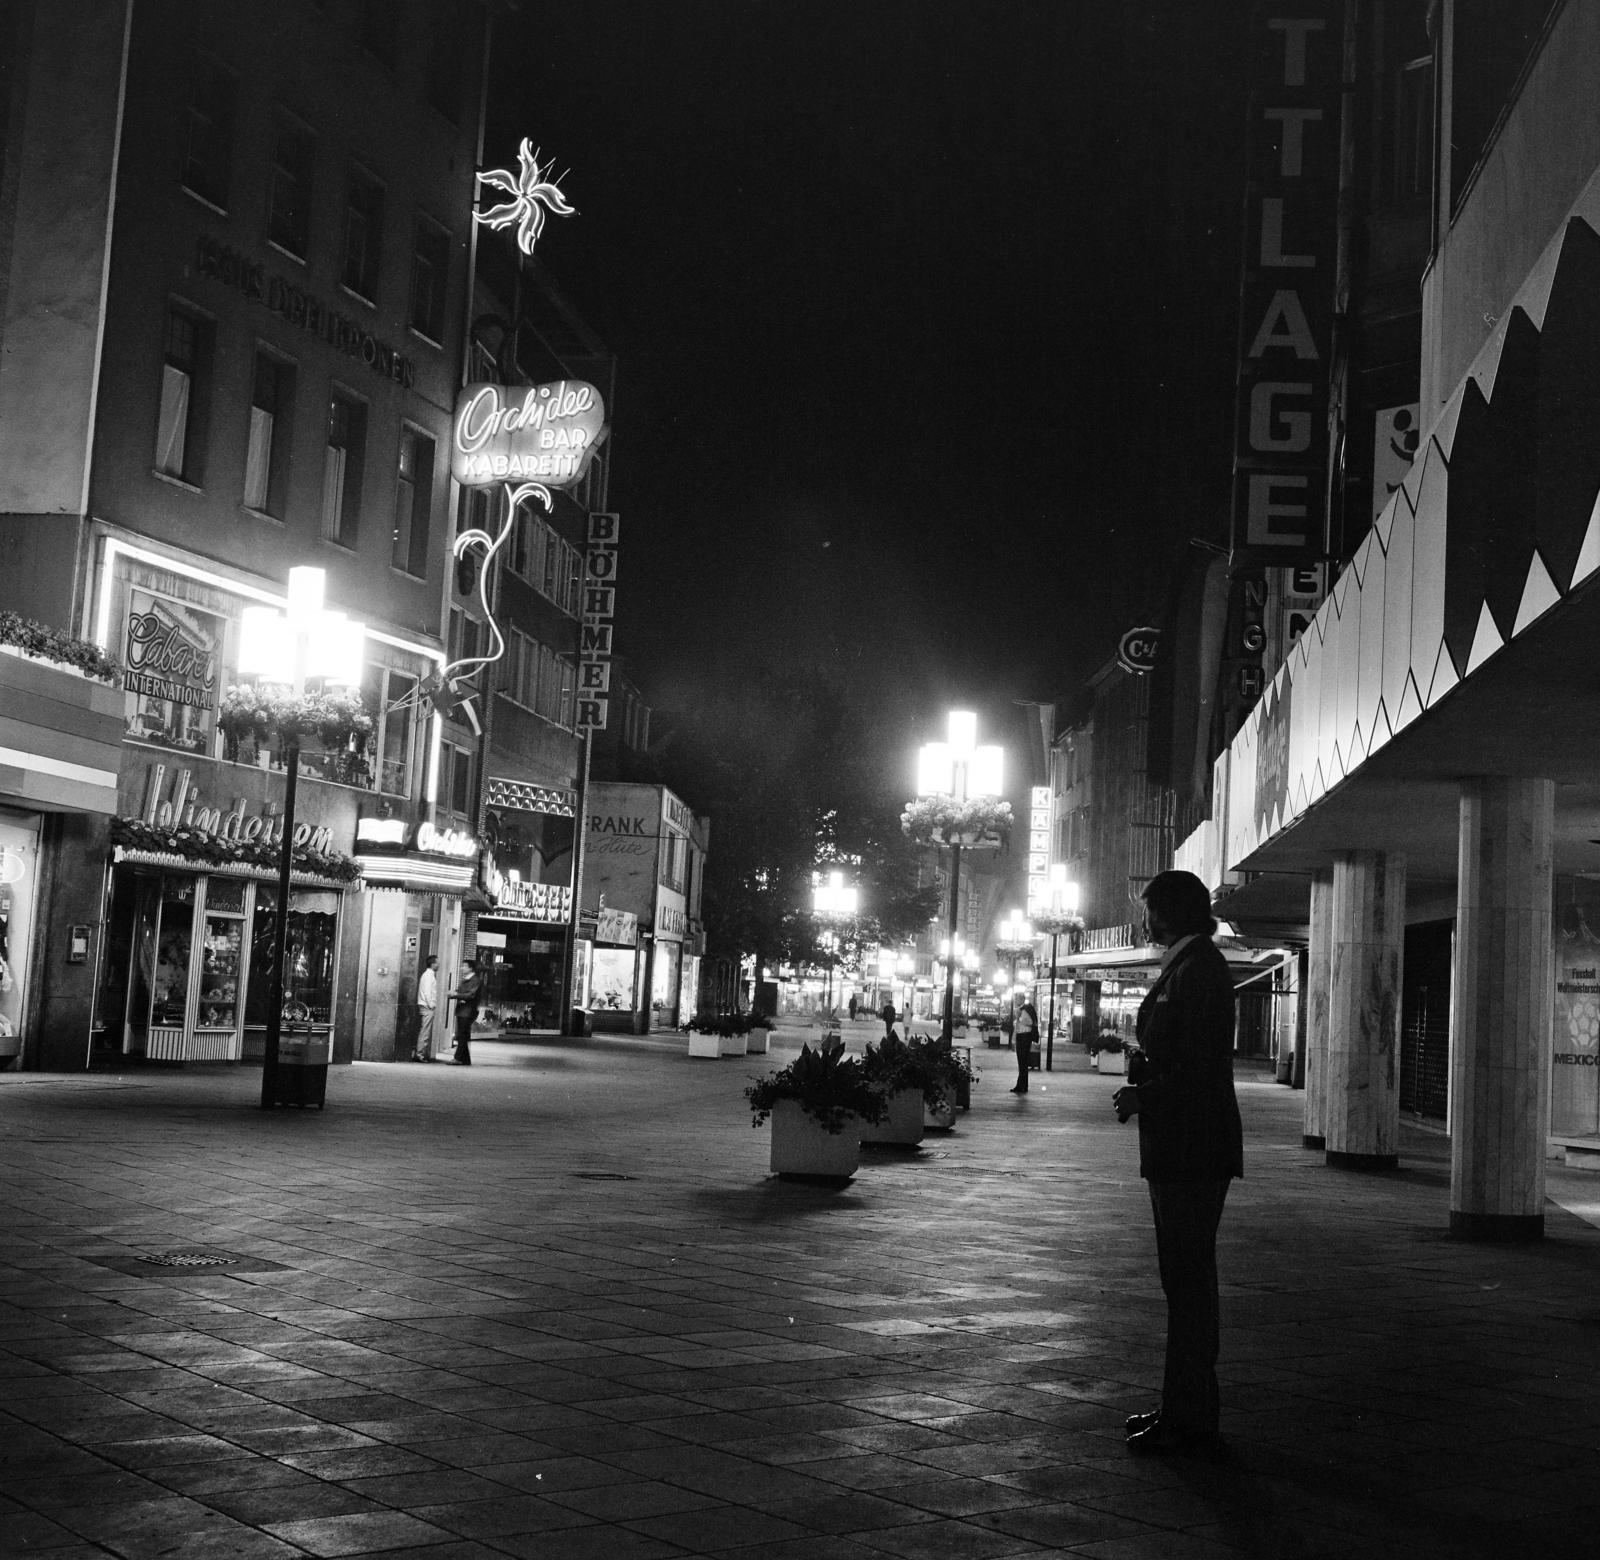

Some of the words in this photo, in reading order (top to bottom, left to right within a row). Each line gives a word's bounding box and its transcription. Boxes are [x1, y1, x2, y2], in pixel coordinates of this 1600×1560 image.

[456, 380, 595, 453] Orchidee
[540, 428, 588, 449] BAR
[463, 455, 576, 477] KABARETT
[578, 514, 615, 726] BÖHMER
[128, 612, 222, 689] Cabaret
[126, 671, 214, 710] INTERNATIONAL
